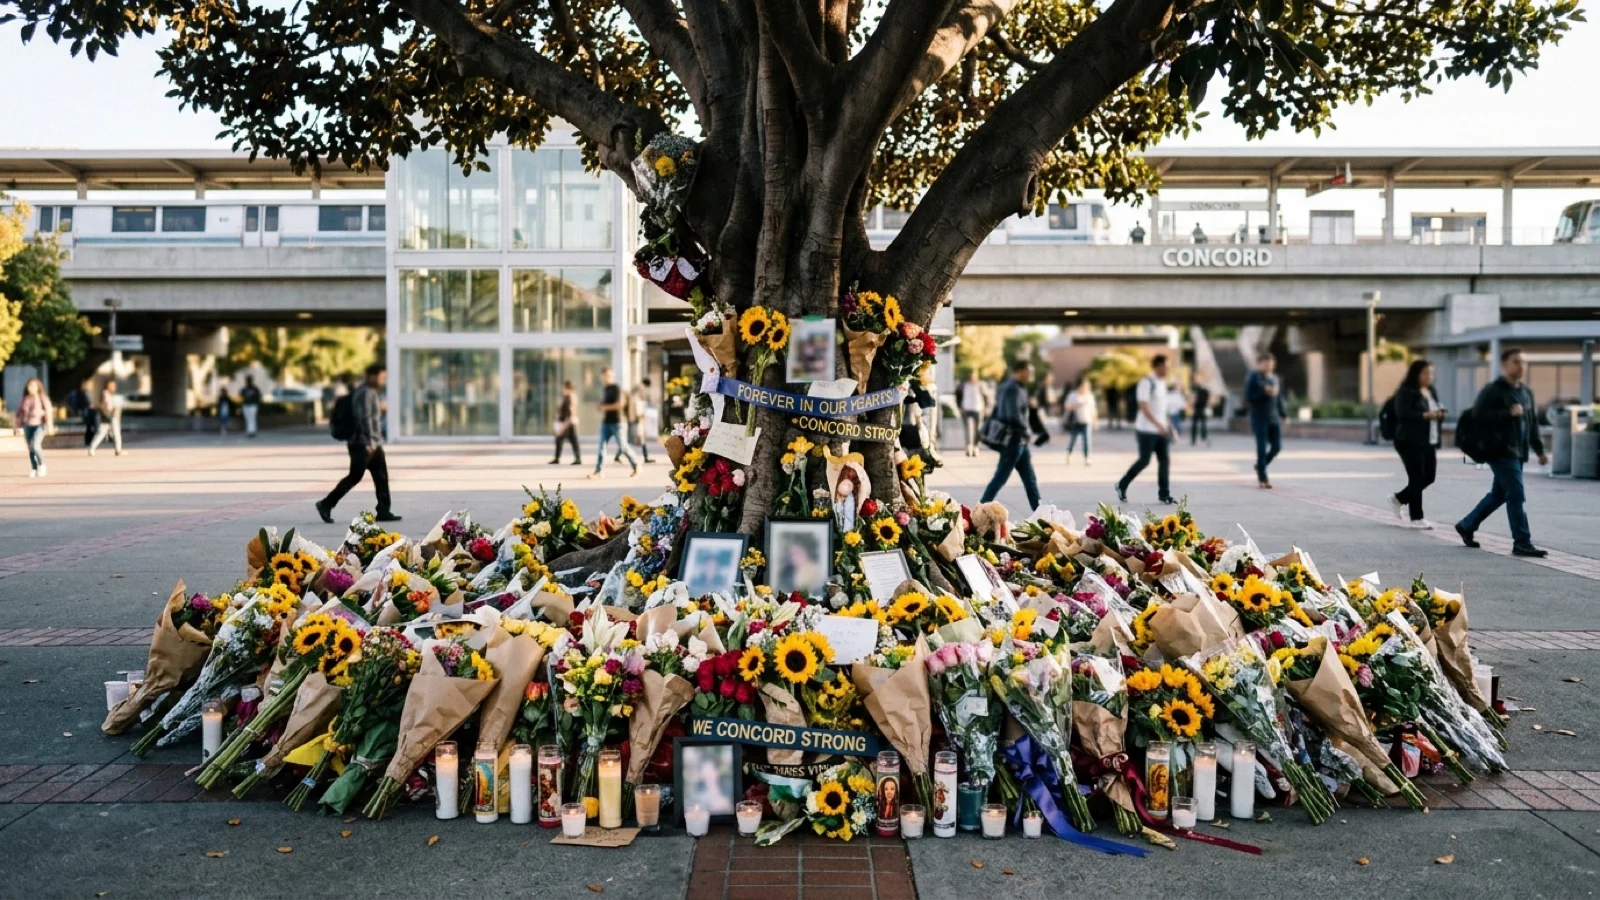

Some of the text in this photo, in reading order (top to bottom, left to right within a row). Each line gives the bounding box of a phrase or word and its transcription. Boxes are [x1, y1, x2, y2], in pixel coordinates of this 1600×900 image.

[1162, 248, 1273, 267] CONCORD
[800, 398, 814, 412] IN
[819, 401, 847, 415] OUR
[799, 416, 860, 437] CONCORD
[692, 719, 866, 752] WE CONCORD STRONG
